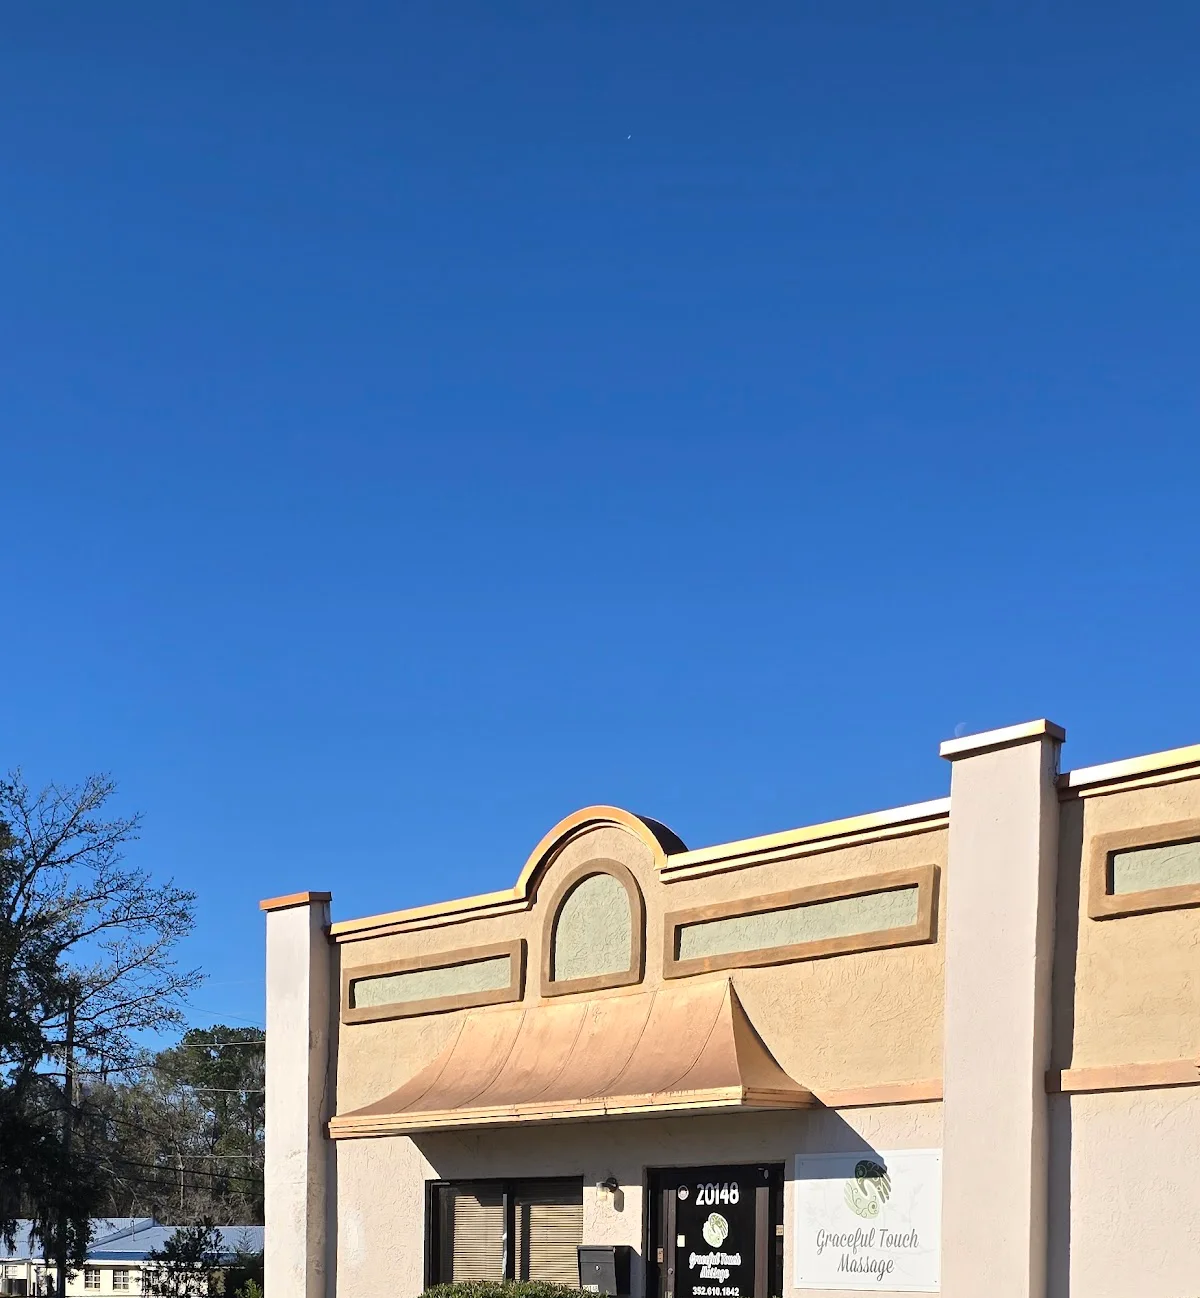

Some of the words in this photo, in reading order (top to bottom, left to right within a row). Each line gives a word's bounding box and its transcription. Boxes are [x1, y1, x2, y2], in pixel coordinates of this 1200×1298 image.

[695, 1181, 740, 1206] 20148
[816, 1227, 876, 1255] Graceful
[879, 1228, 919, 1248] Touch
[836, 1253, 895, 1281] Massage
[692, 1286, 740, 1297] 352.610.1842
